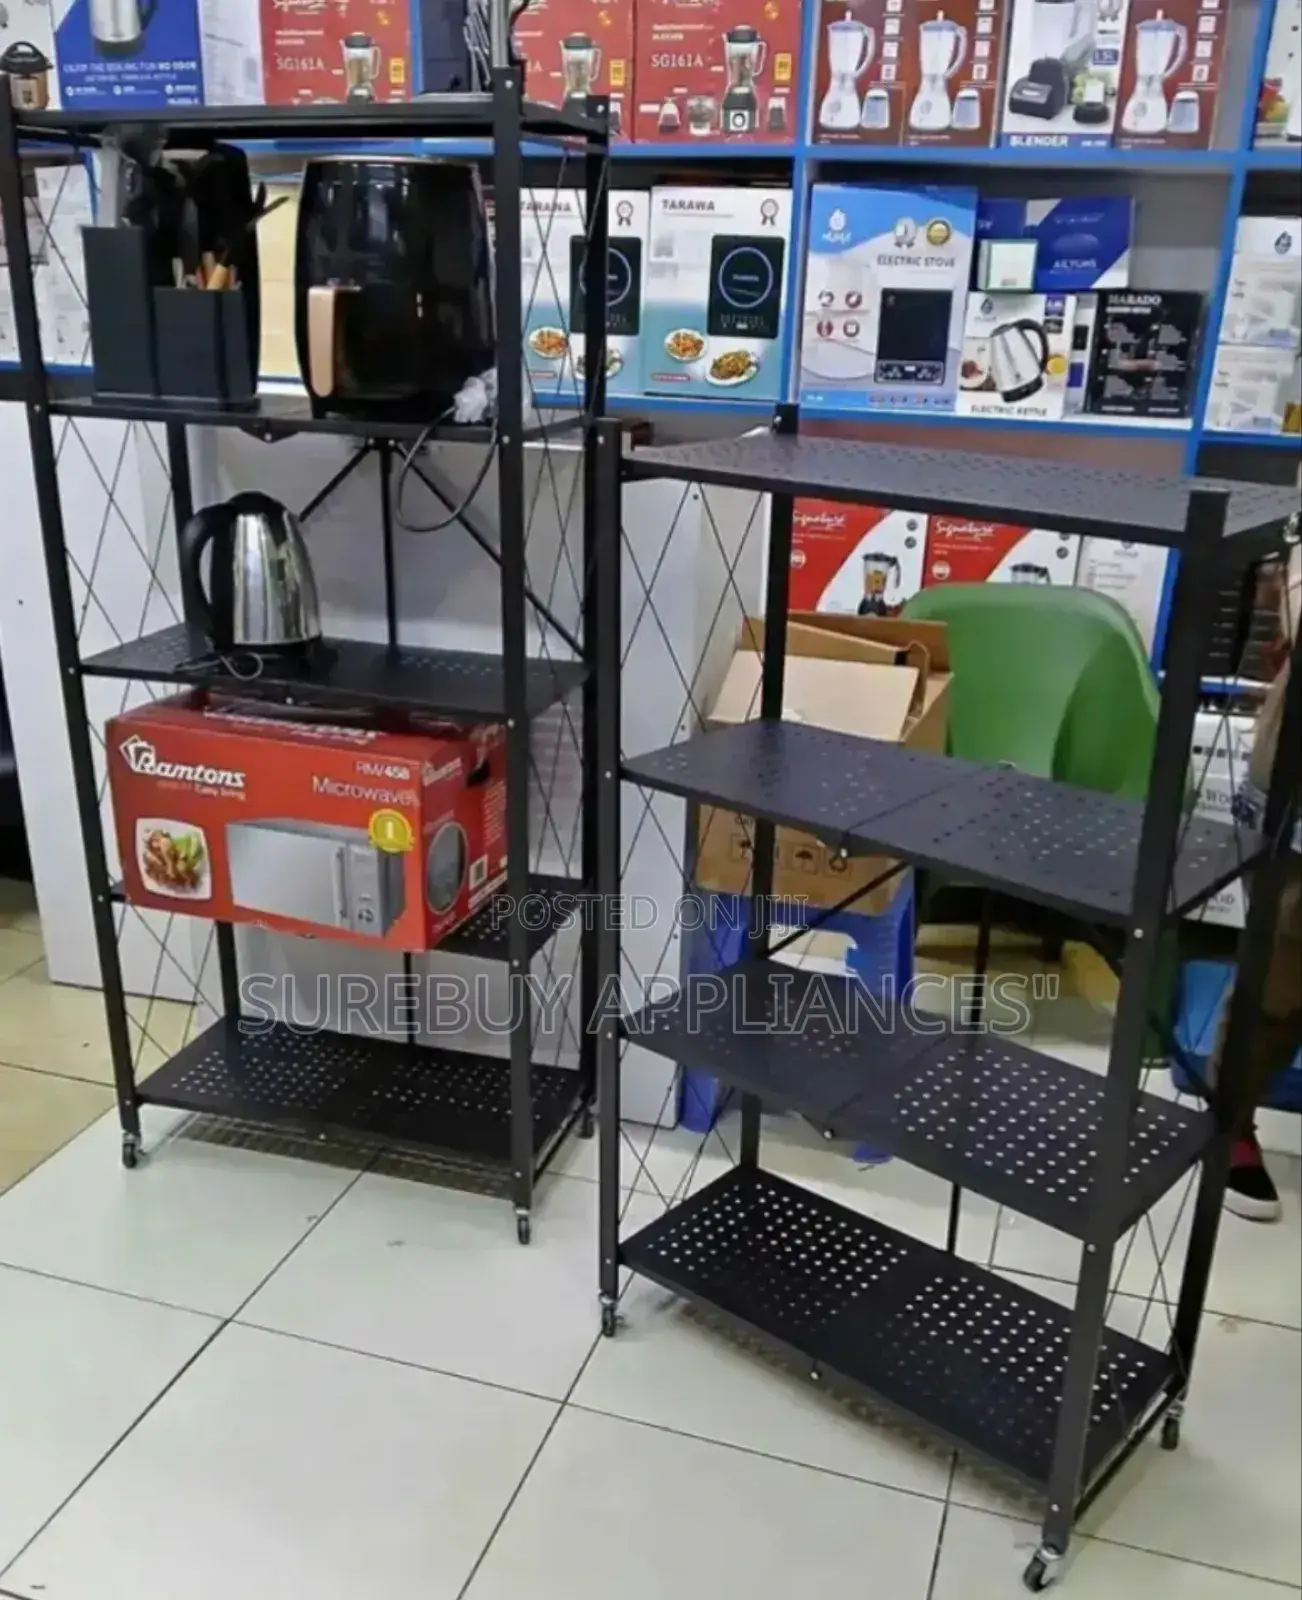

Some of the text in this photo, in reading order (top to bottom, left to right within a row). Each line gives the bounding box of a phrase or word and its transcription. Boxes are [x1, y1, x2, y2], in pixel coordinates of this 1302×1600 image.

[651, 53, 704, 68] SG161A
[1009, 135, 1068, 147] BLENDER
[661, 199, 716, 211] TARAWA
[877, 254, 956, 268] ELECTRIC STOVE
